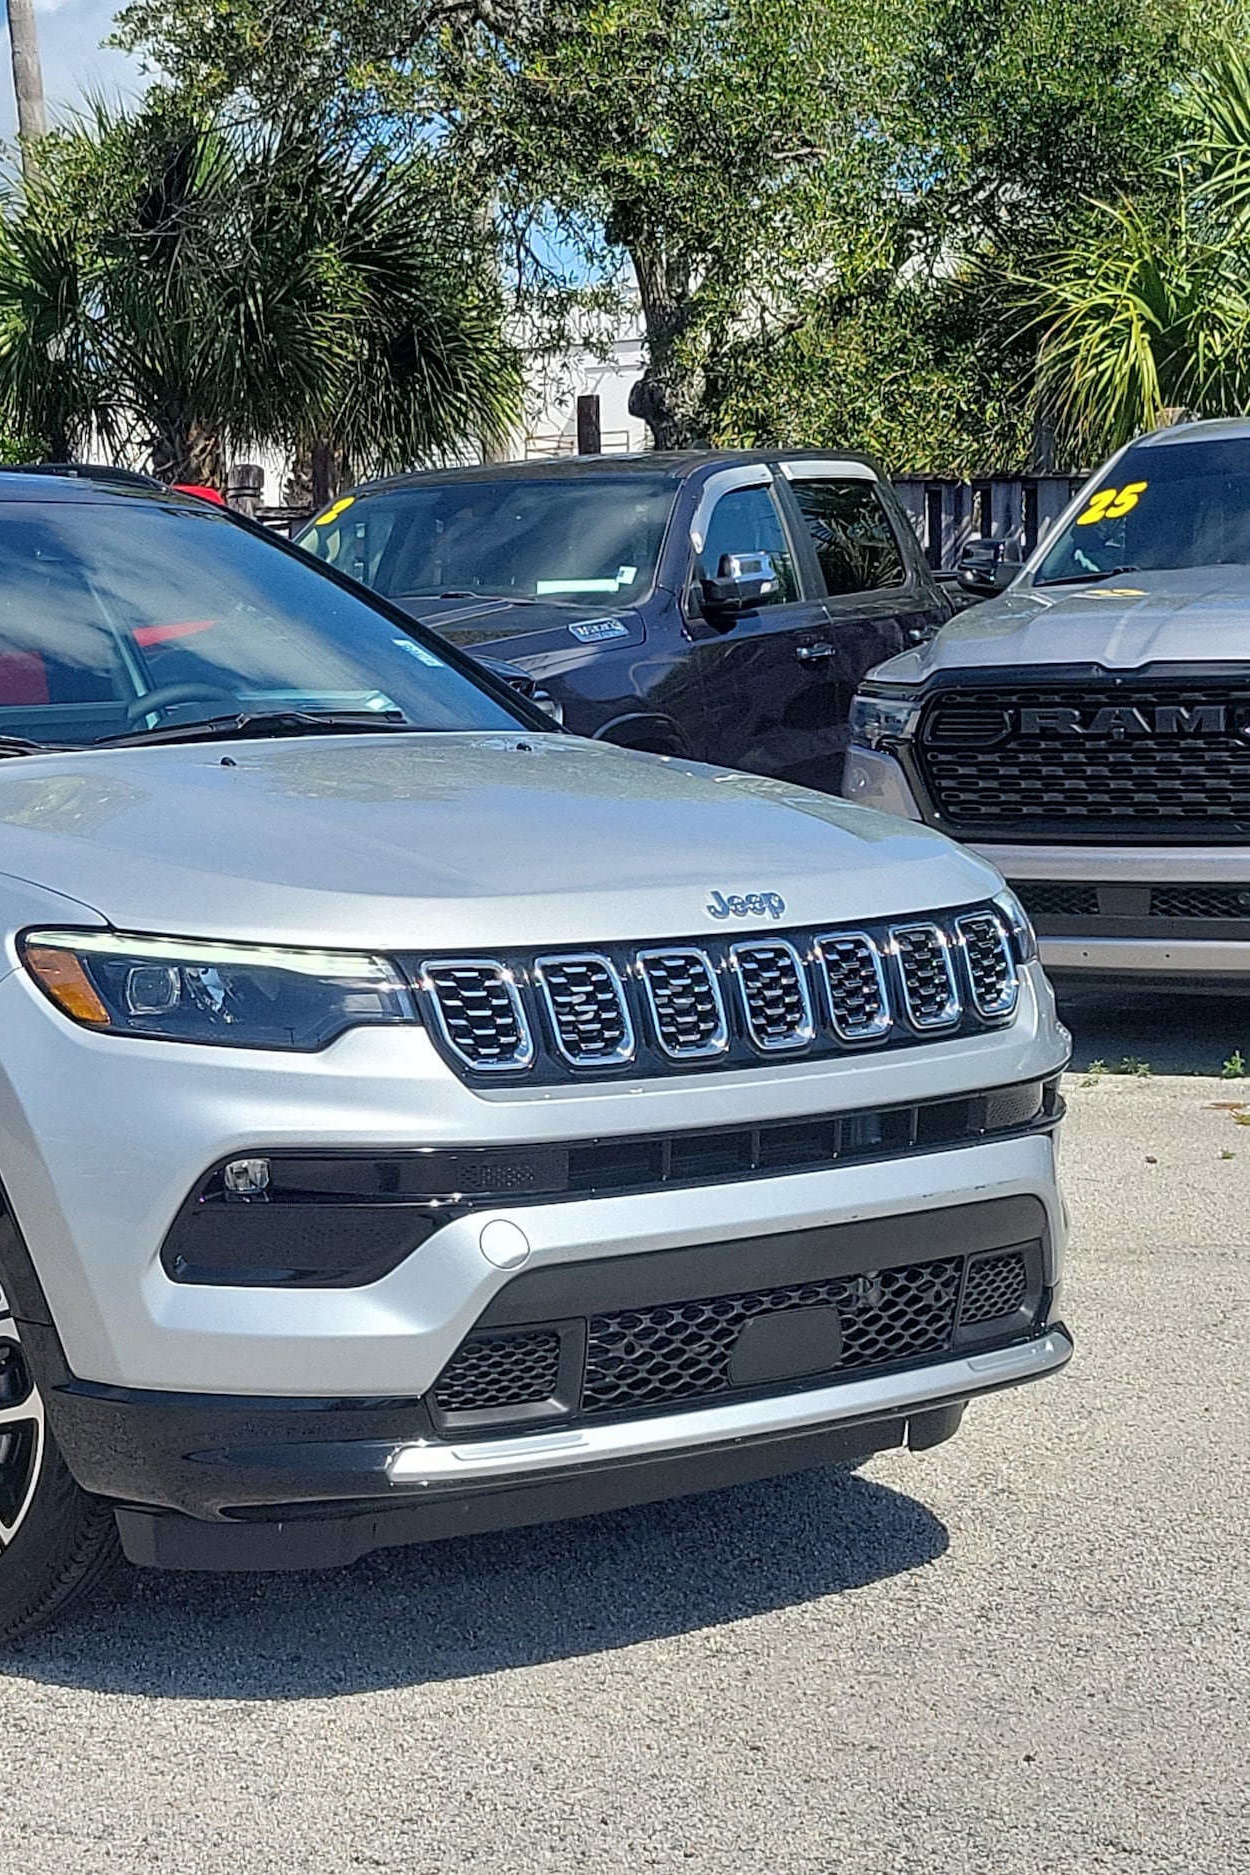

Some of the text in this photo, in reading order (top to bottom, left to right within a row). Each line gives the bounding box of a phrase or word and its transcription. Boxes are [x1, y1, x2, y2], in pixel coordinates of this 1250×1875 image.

[1076, 481, 1148, 525] 25
[1019, 705, 1226, 734] RAM
[705, 889, 786, 920] Jeep
